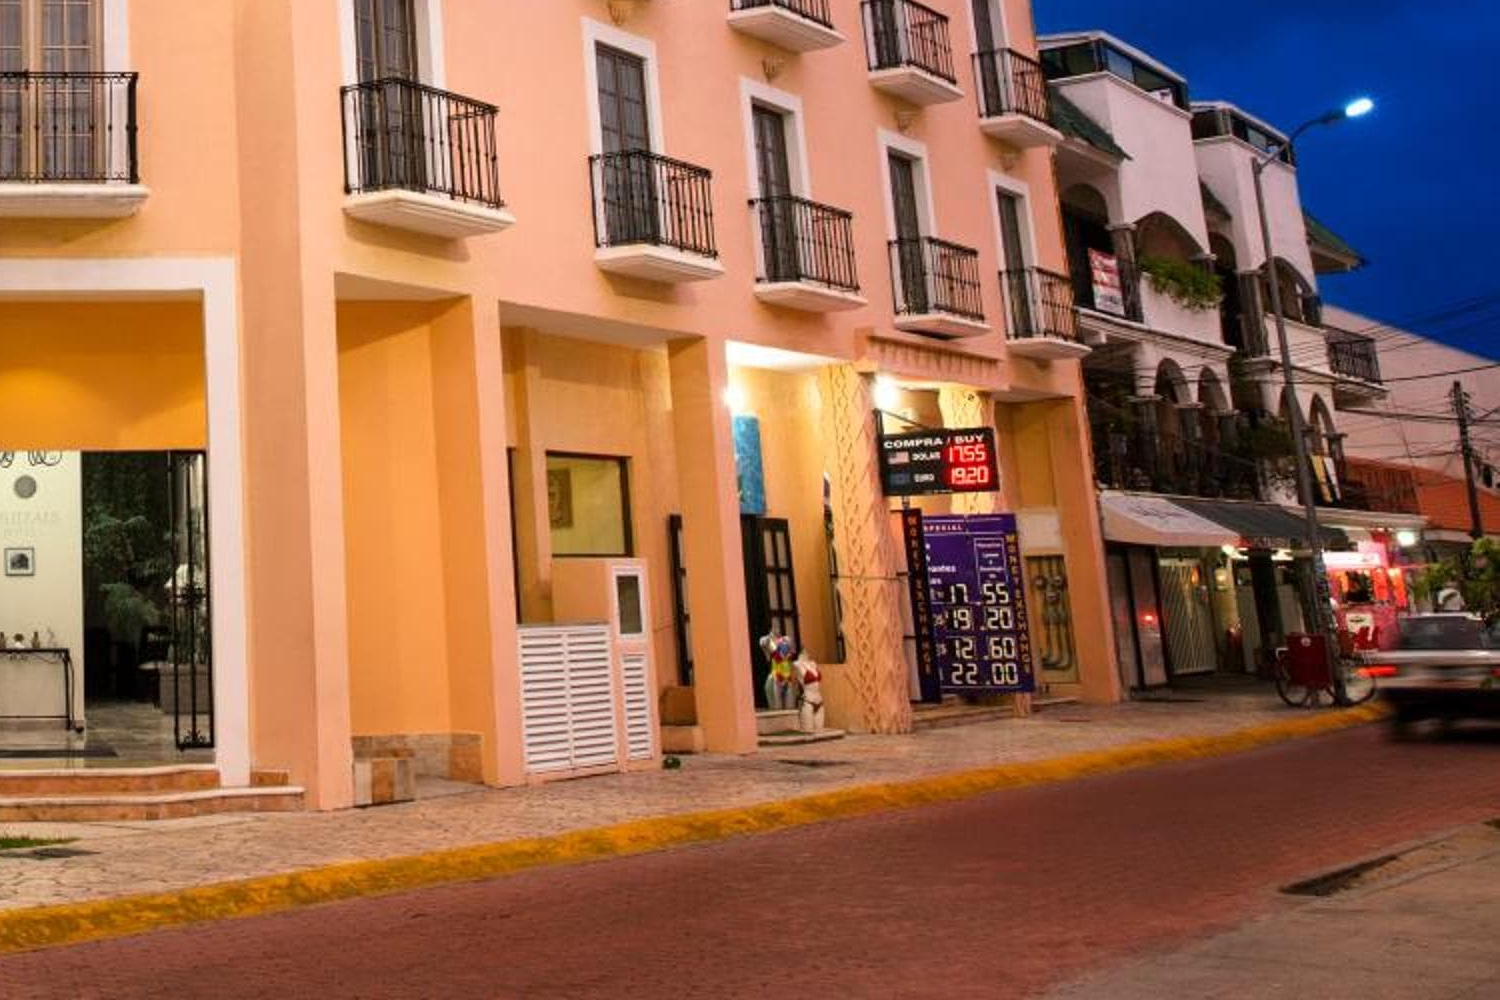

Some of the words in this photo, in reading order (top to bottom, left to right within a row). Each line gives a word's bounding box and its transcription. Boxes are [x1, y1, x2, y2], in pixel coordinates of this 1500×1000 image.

[883, 437, 943, 449] COMPRA
[954, 433, 984, 445] BUY
[1005, 534, 1019, 584] MONEY
[1015, 588, 1030, 673] EXCHANGE
